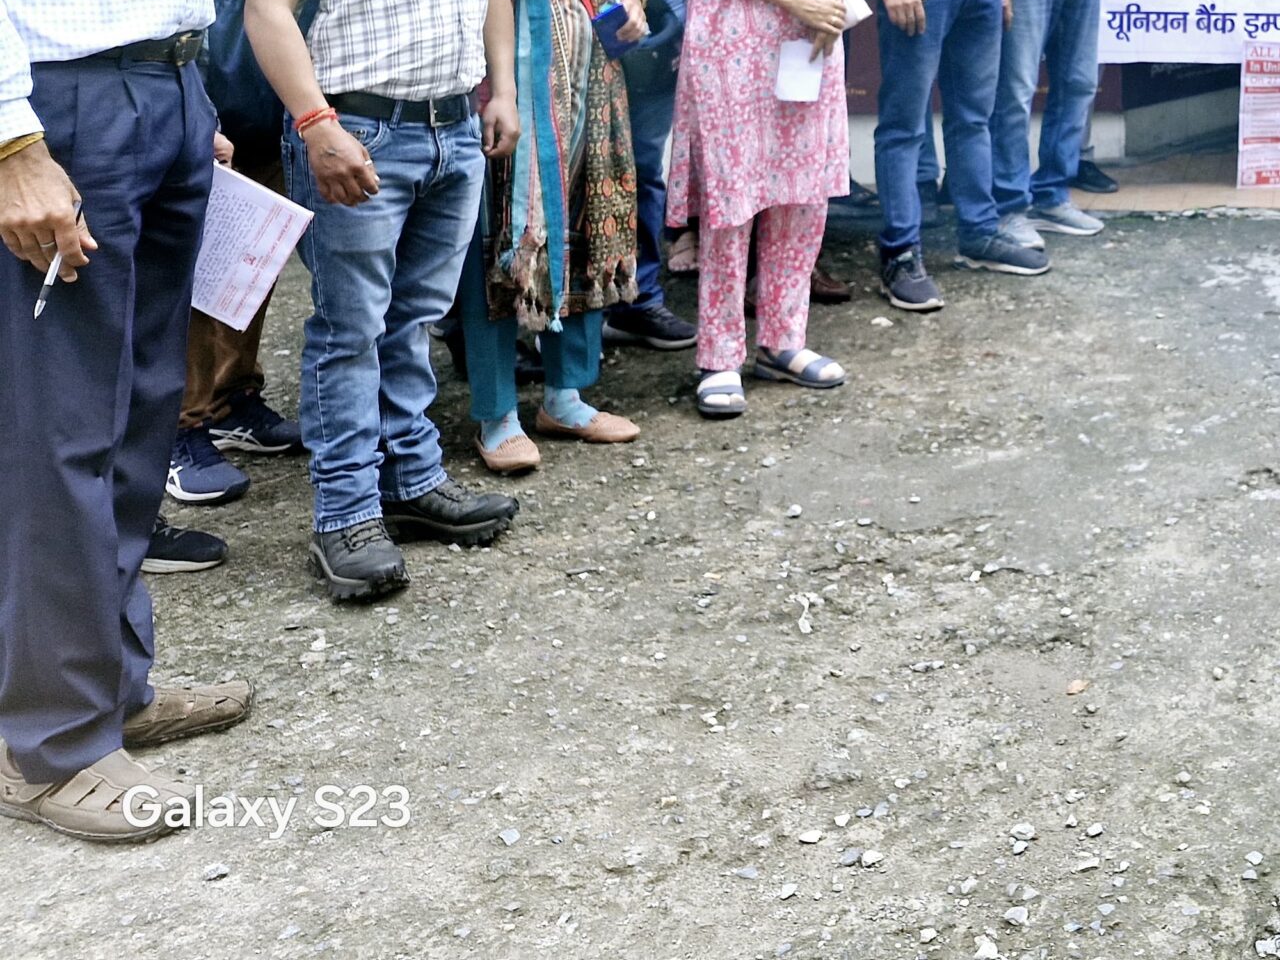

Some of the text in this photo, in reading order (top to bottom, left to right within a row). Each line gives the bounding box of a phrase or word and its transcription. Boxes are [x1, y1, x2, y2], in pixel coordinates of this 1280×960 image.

[1107, 3, 1190, 42] यूनियन
[1196, 3, 1238, 34] बैंक
[1250, 46, 1275, 58] ALL
[1250, 61, 1261, 72] In
